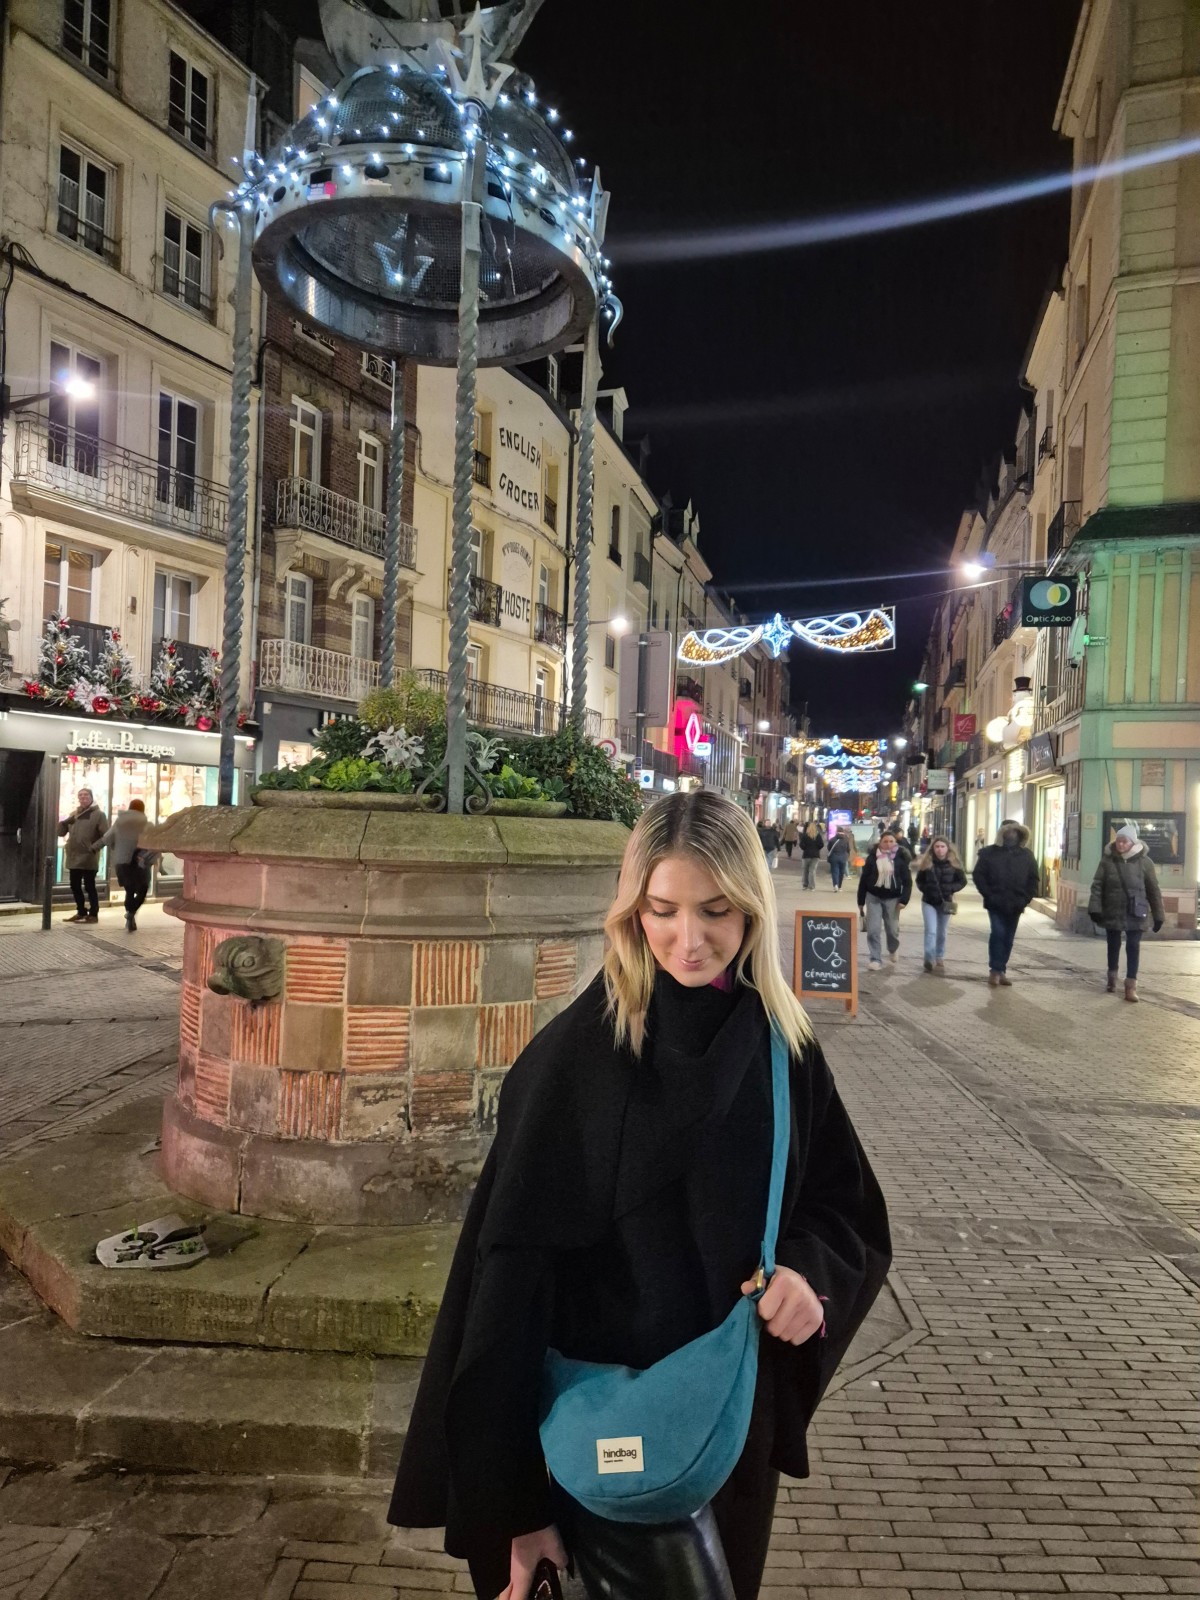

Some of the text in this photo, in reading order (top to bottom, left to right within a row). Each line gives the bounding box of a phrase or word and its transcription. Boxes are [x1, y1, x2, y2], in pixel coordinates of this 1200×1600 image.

[499, 427, 541, 469] ENGLISH
[499, 473, 539, 510] GROCER
[1026, 614, 1050, 624] Optic
[66, 729, 102, 751] Jeff
[119, 730, 176, 758] Bruges
[603, 1447, 637, 1460] hindbag
